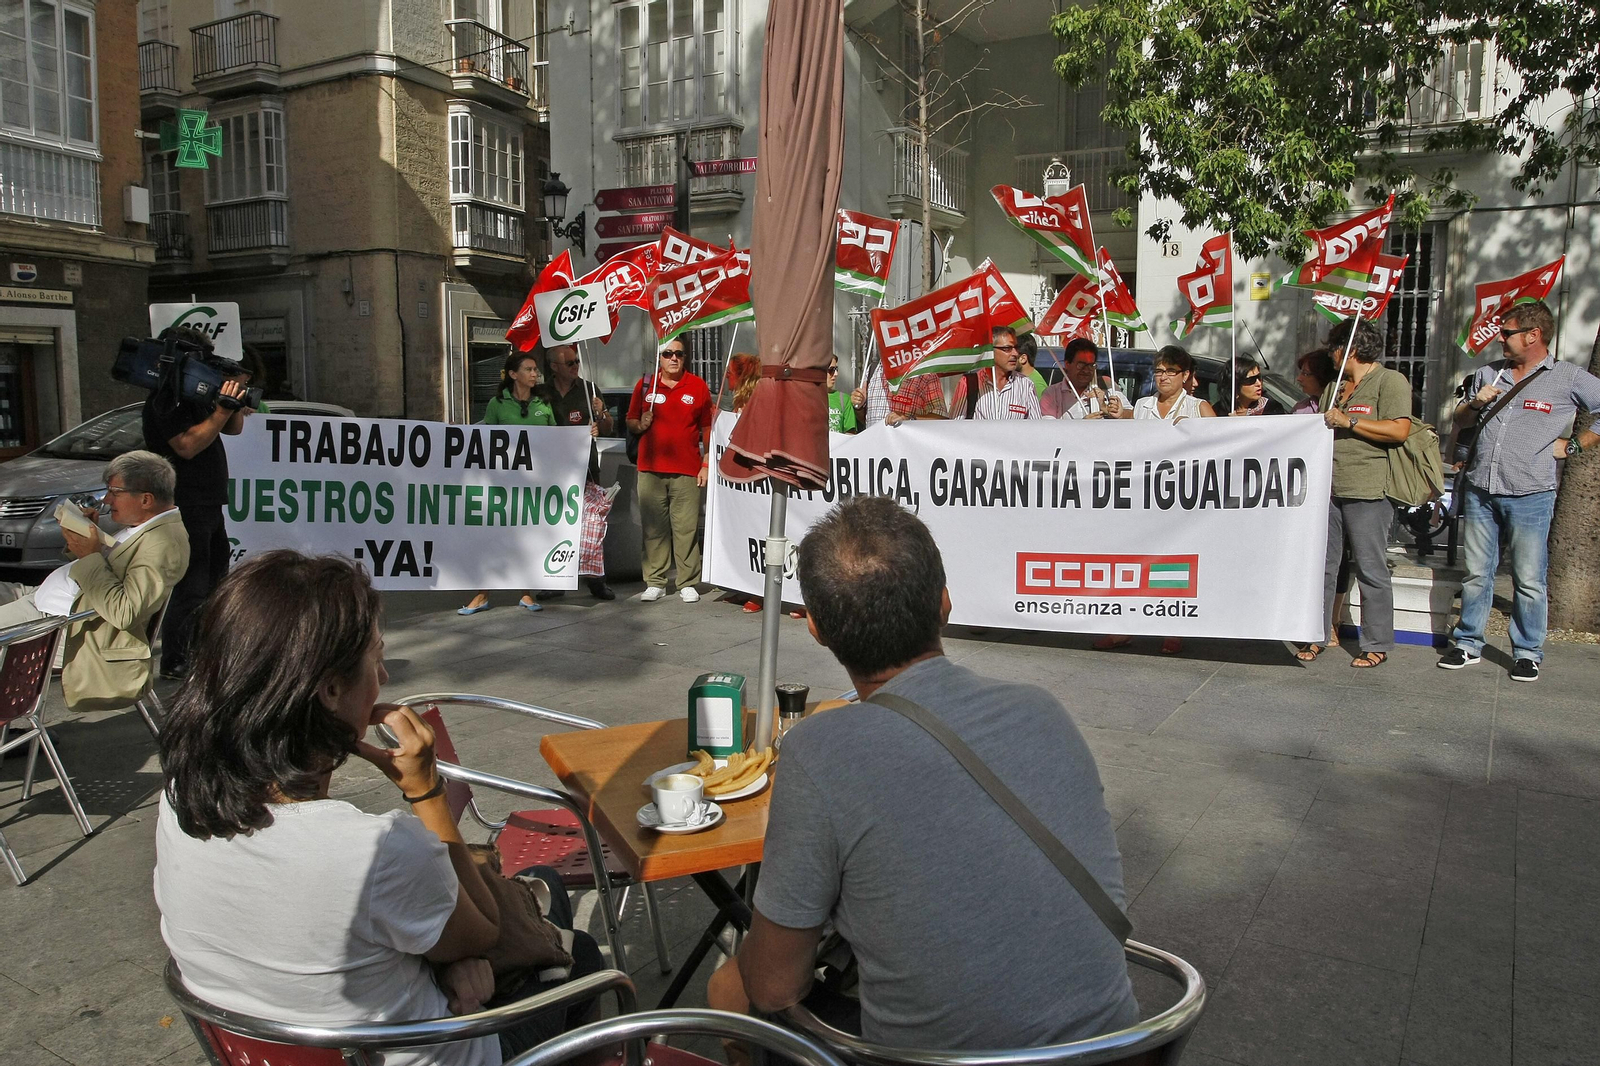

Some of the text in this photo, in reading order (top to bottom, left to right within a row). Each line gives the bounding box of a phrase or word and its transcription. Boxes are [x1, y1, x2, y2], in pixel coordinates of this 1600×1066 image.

[694, 160, 757, 175] CALLE ZORRILLA
[650, 187, 665, 195] PLAZA
[628, 194, 673, 207] SAN ANTONIO
[641, 214, 665, 223] ORATORIO
[617, 225, 631, 235] SAN
[632, 223, 655, 234] FELIPE
[1162, 243, 1179, 257] 18
[6, 290, 37, 300] Alonso
[40, 292, 68, 301] Barthe
[266, 419, 533, 471] TRABAJO PARA
[929, 447, 1082, 509] GARANTÍA
[1092, 460, 1132, 510] DE
[1143, 457, 1308, 511] IGUALDAD
[228, 478, 580, 527] UESTROS INTERINOS
[1025, 561, 1141, 589] CCOO
[1014, 599, 1122, 616] enseñanza
[1142, 600, 1199, 618] cádiz
